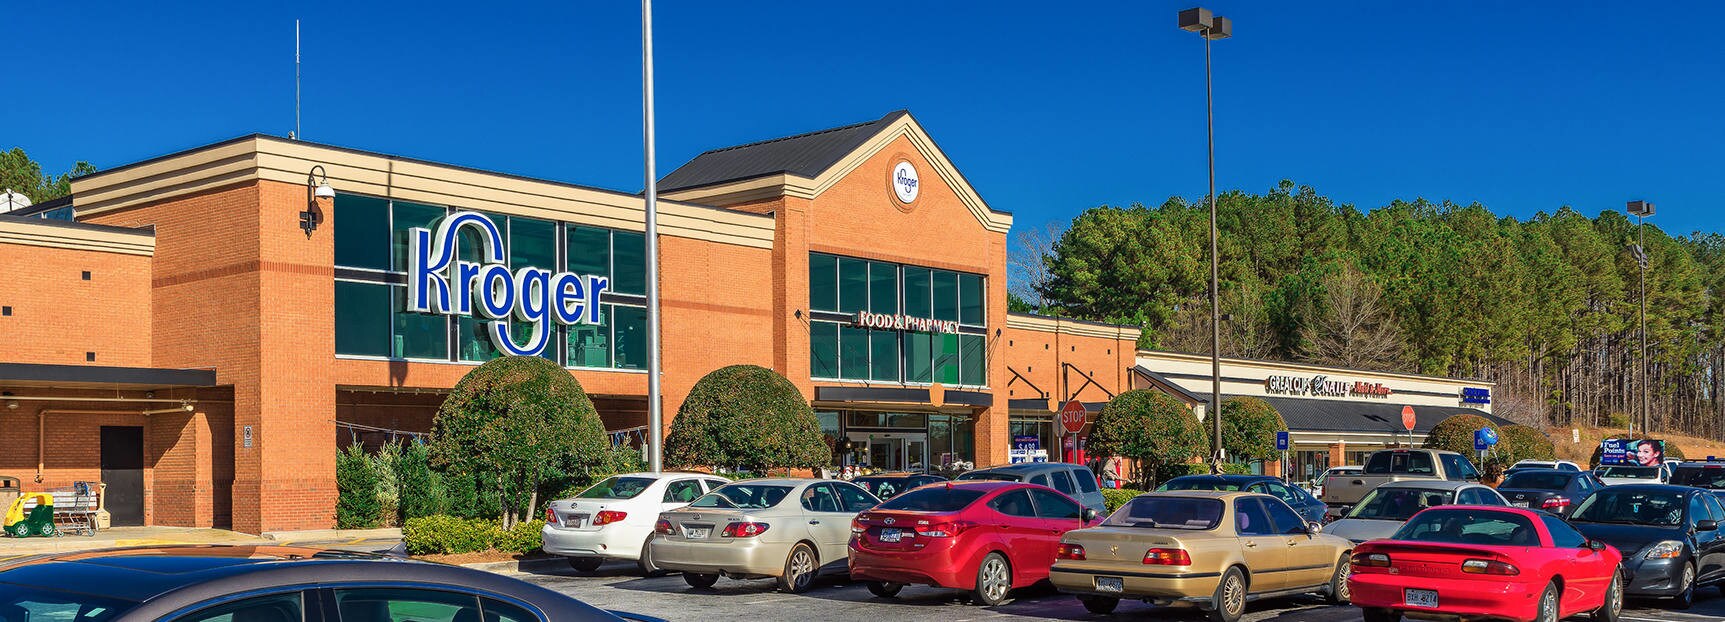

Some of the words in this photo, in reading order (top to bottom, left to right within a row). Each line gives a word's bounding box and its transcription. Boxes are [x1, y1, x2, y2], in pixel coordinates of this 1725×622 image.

[897, 168, 917, 193] Kroger
[407, 211, 609, 357] Kroger
[858, 310, 893, 328] FOOD
[904, 315, 960, 334] PHARMACY
[1063, 409, 1085, 424] STOP
